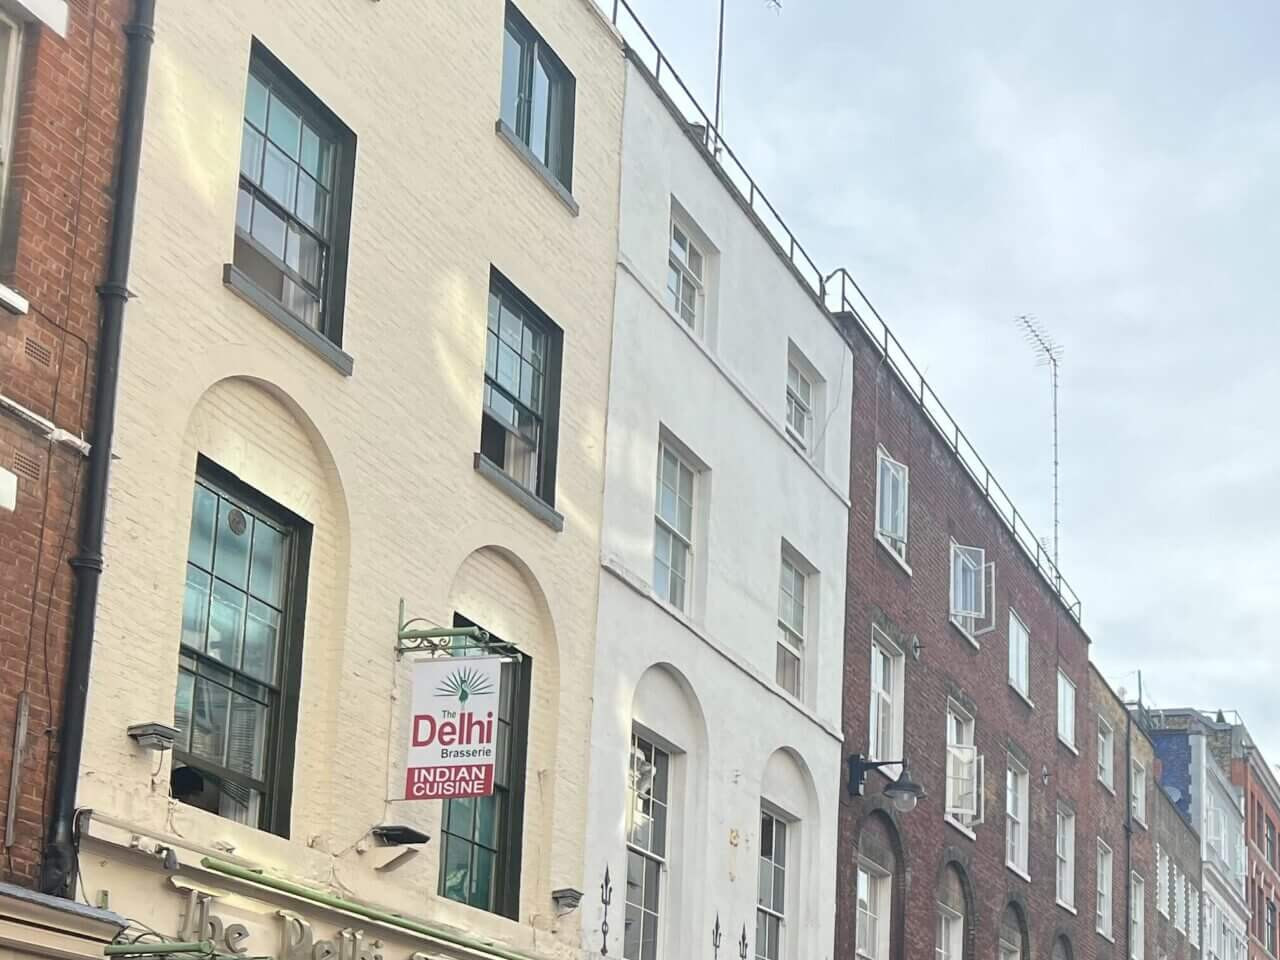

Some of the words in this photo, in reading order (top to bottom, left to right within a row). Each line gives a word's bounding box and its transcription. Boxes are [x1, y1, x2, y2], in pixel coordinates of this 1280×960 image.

[441, 710, 456, 719] The
[412, 711, 493, 747] Delhi
[441, 747, 492, 759] Brasserie
[414, 766, 486, 783] INDIAN
[413, 780, 485, 796] CUISINE
[170, 876, 249, 954] The
